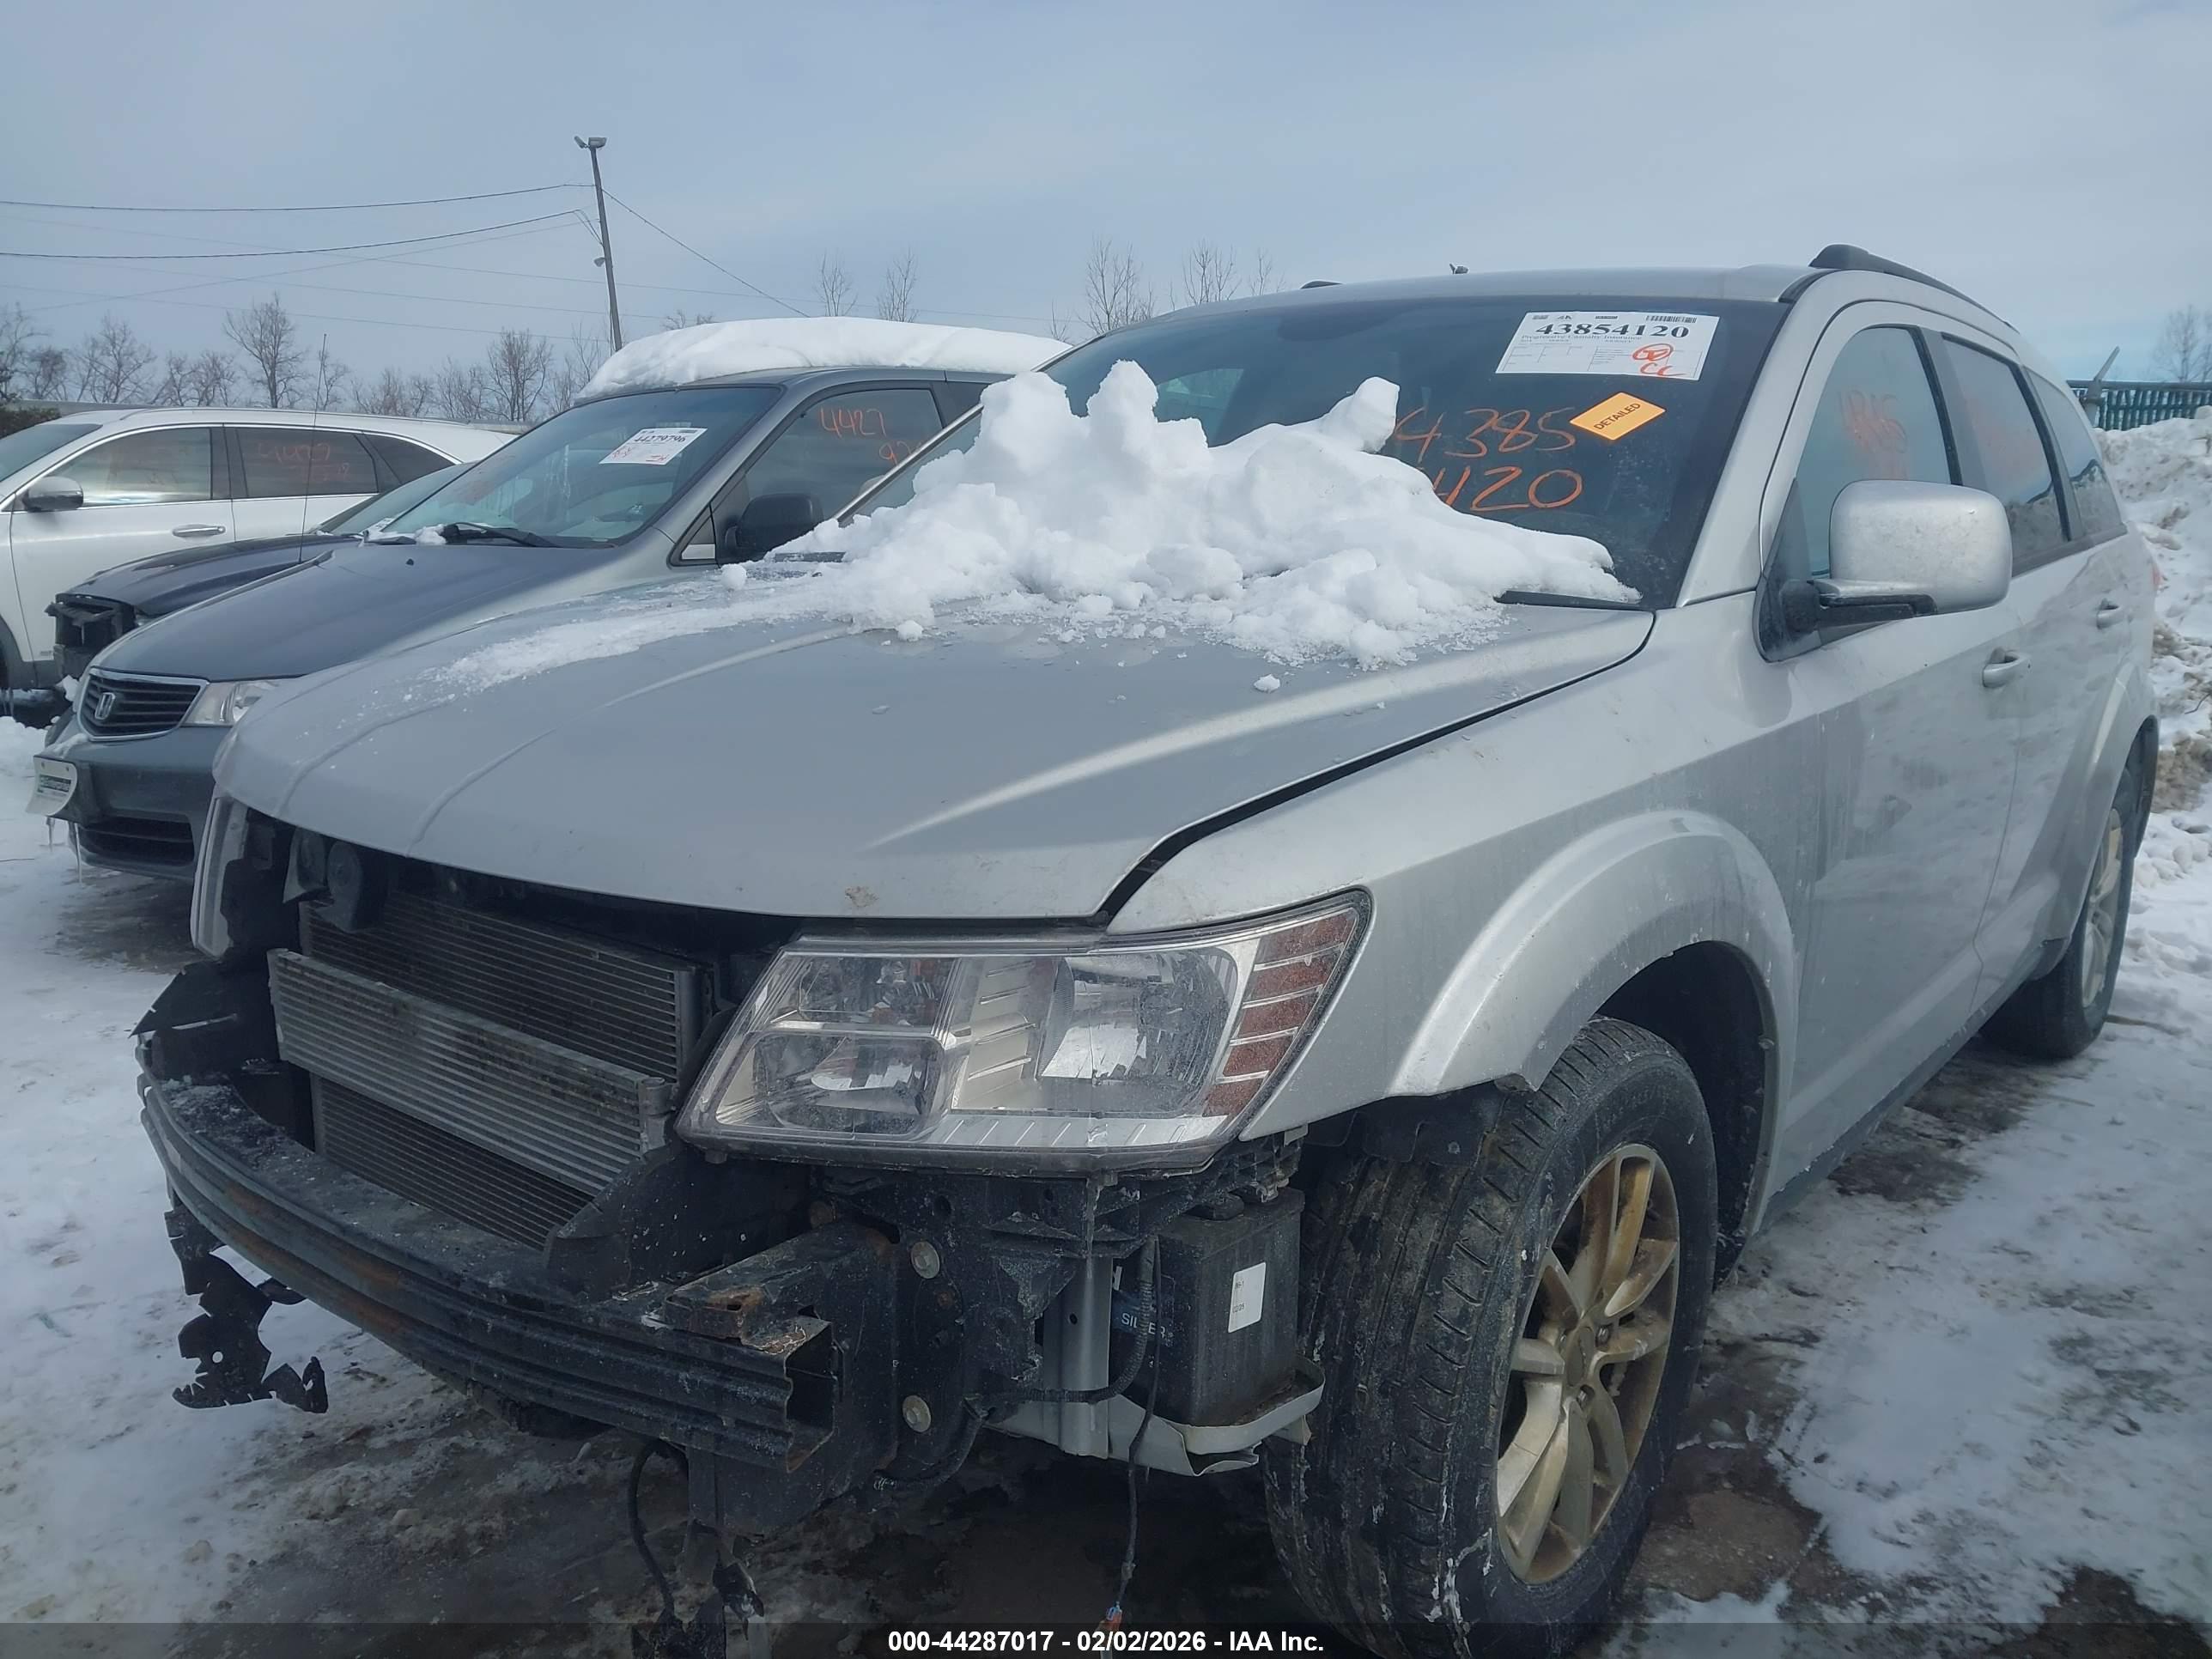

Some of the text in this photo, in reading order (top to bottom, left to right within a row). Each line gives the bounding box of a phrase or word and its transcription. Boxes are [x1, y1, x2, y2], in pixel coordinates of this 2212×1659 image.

[1535, 323, 1691, 339] 43854120
[819, 407, 887, 439] 4427
[1593, 403, 1641, 430] DETAILED
[1395, 407, 1576, 463] 4385
